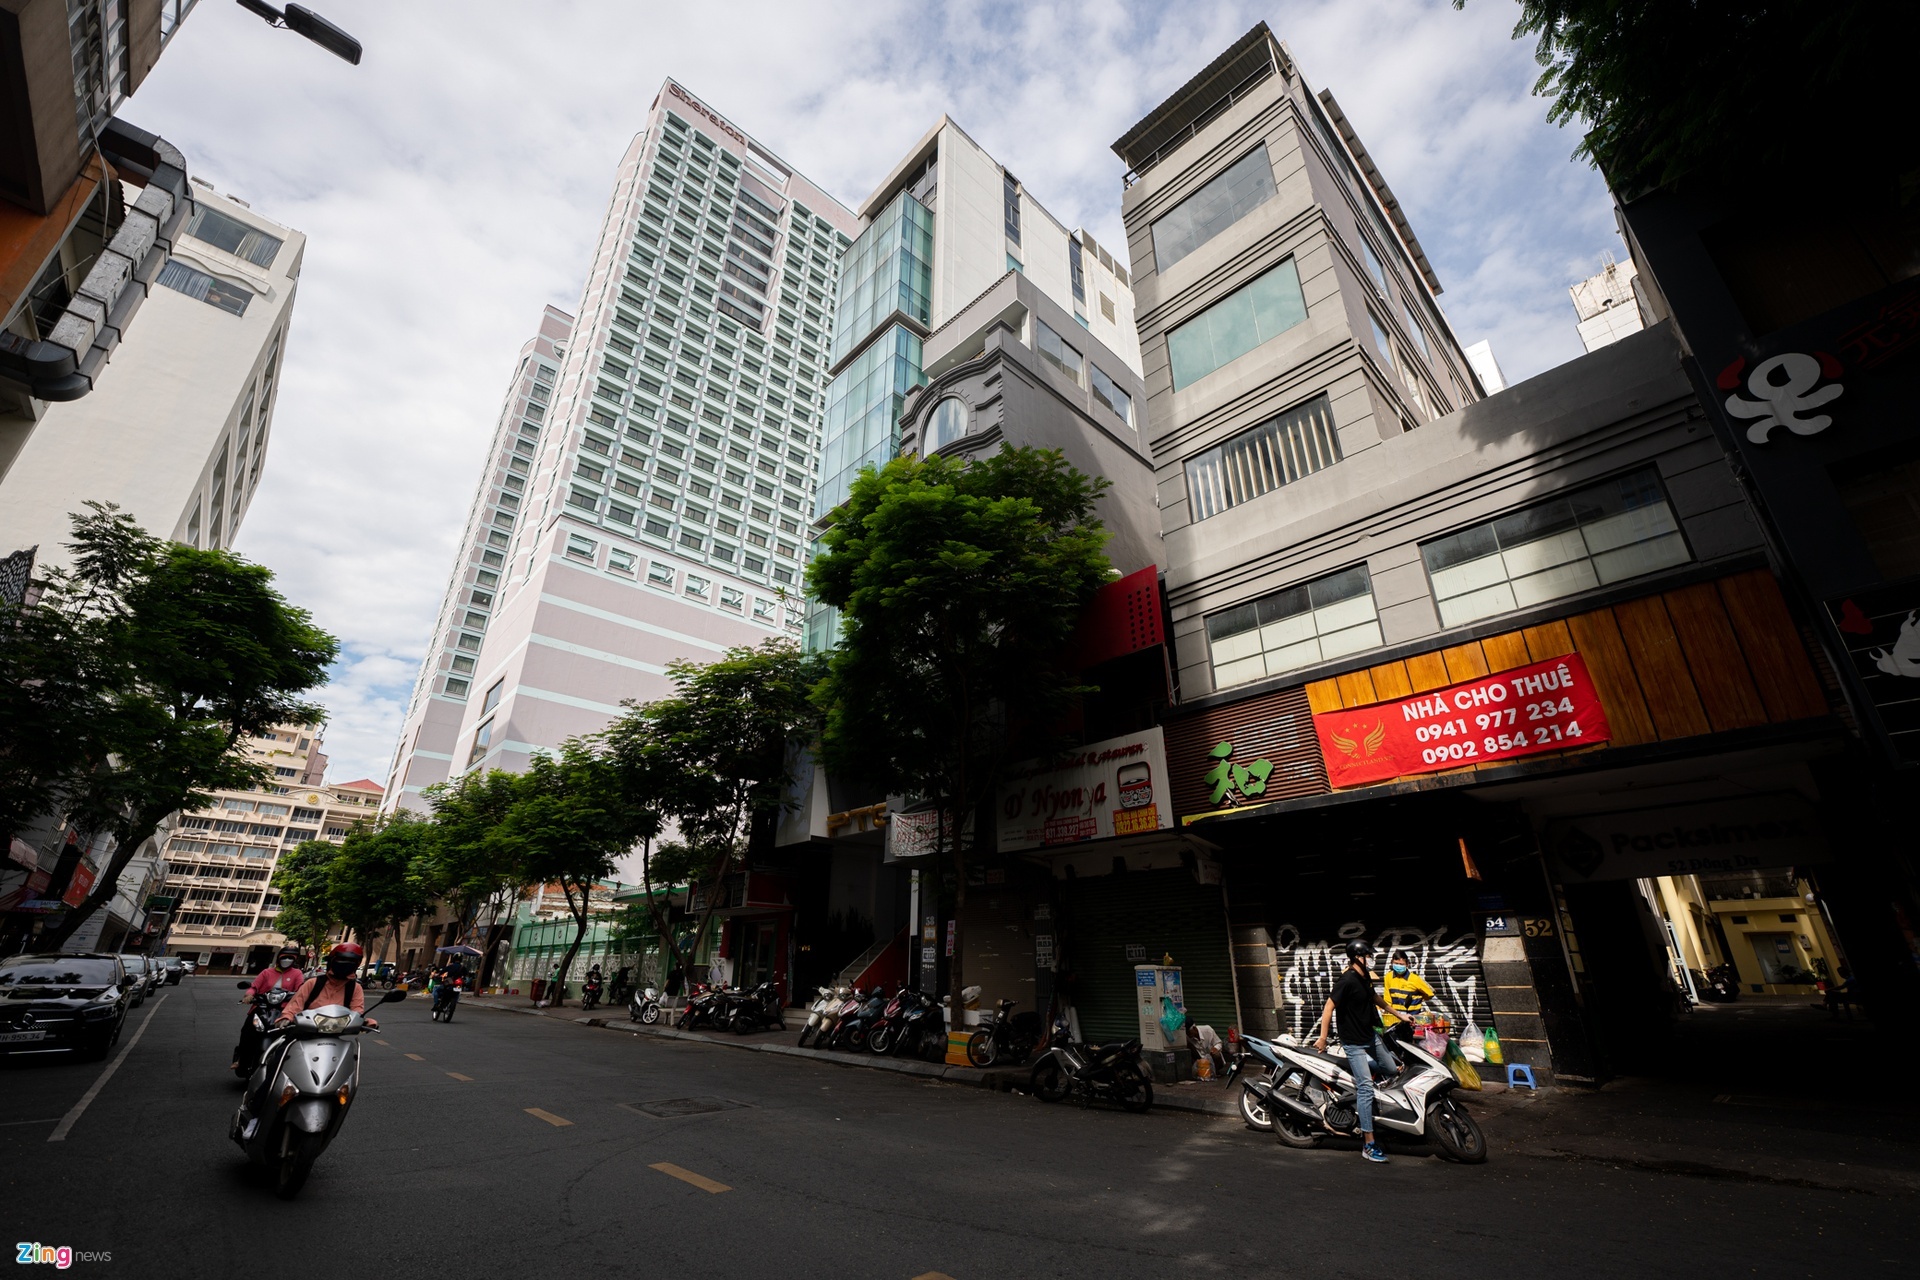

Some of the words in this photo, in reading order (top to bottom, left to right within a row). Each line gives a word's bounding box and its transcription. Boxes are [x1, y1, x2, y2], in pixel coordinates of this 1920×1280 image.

[669, 83, 745, 145] Sheraton
[1401, 692, 1451, 722] NHÀ
[1454, 683, 1507, 710] CHO
[1511, 663, 1575, 698] THUÊ
[1415, 718, 1468, 743] 0941
[1475, 708, 1517, 731] 977
[1526, 697, 1575, 720] 234
[1422, 740, 1478, 764] 0902
[1484, 731, 1529, 754] 854
[1534, 720, 1583, 745] 214
[1611, 818, 1808, 854] Packsimex
[1668, 859, 1687, 873] 52
[1735, 854, 1761, 868] Du
[1486, 916, 1505, 928] 54
[1524, 918, 1554, 938] 52
